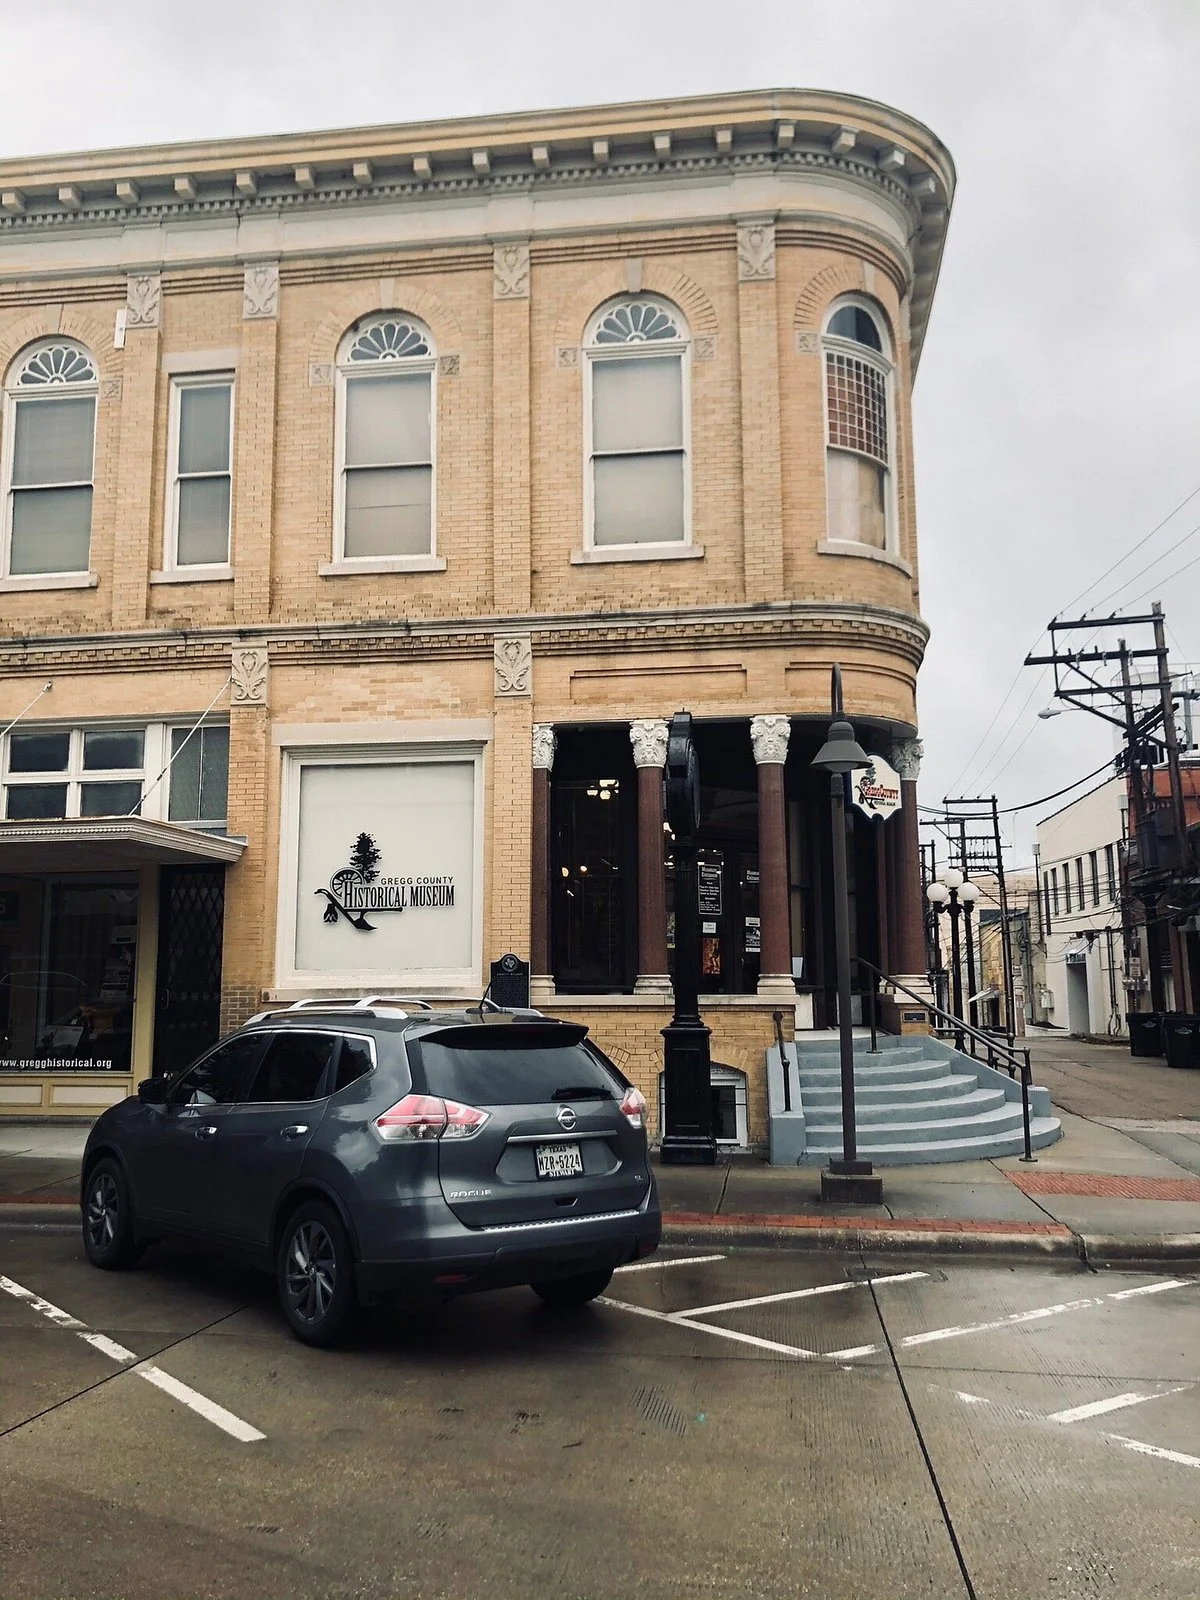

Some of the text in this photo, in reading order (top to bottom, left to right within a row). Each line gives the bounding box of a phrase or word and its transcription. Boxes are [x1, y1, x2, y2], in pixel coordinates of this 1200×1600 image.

[381, 876, 454, 885] GREGG COUNTY
[343, 881, 455, 908] HISTORICAL MUSEUM
[549, 1145, 567, 1153] TEXAS
[450, 1189, 492, 1198] ROGUE
